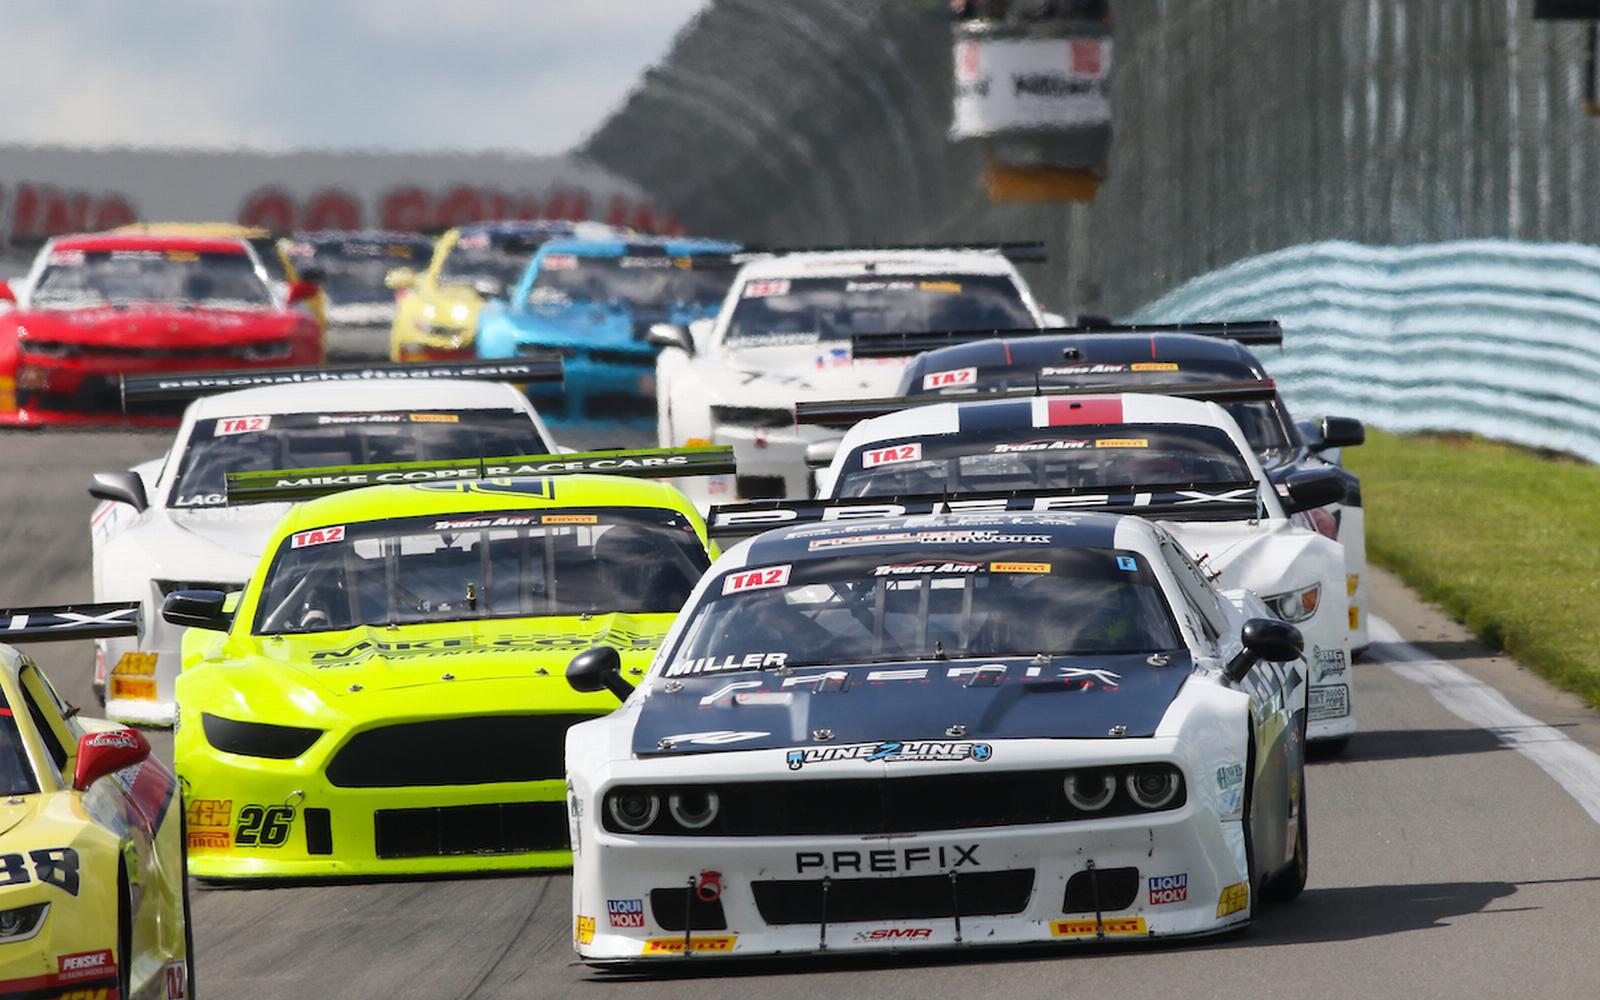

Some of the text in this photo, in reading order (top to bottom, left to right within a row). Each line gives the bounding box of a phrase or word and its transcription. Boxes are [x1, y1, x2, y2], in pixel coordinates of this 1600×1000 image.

[1042, 364, 1123, 376] Trans Am
[931, 369, 970, 388] TA2
[223, 418, 265, 433] TA2
[995, 440, 1086, 453] Trans Am
[868, 446, 918, 466] TA2
[276, 456, 689, 487] MIKE COPE RACE CARS
[714, 488, 1257, 527] PREFIX
[434, 516, 531, 530] Trans Am
[294, 527, 344, 546] TA2
[873, 561, 980, 576] Trans Am
[731, 570, 784, 590] TA2
[665, 652, 790, 678] MILLER
[235, 803, 296, 848] 26
[795, 843, 982, 874] PREFIX
[1149, 874, 1187, 890] LIQUI
[1150, 888, 1188, 904] MOLY
[608, 899, 642, 914] LIQUI
[609, 913, 645, 927] MOLY
[869, 928, 933, 940] SMR
[650, 938, 730, 951] PIRLLI
[63, 953, 107, 970] PENSKE
